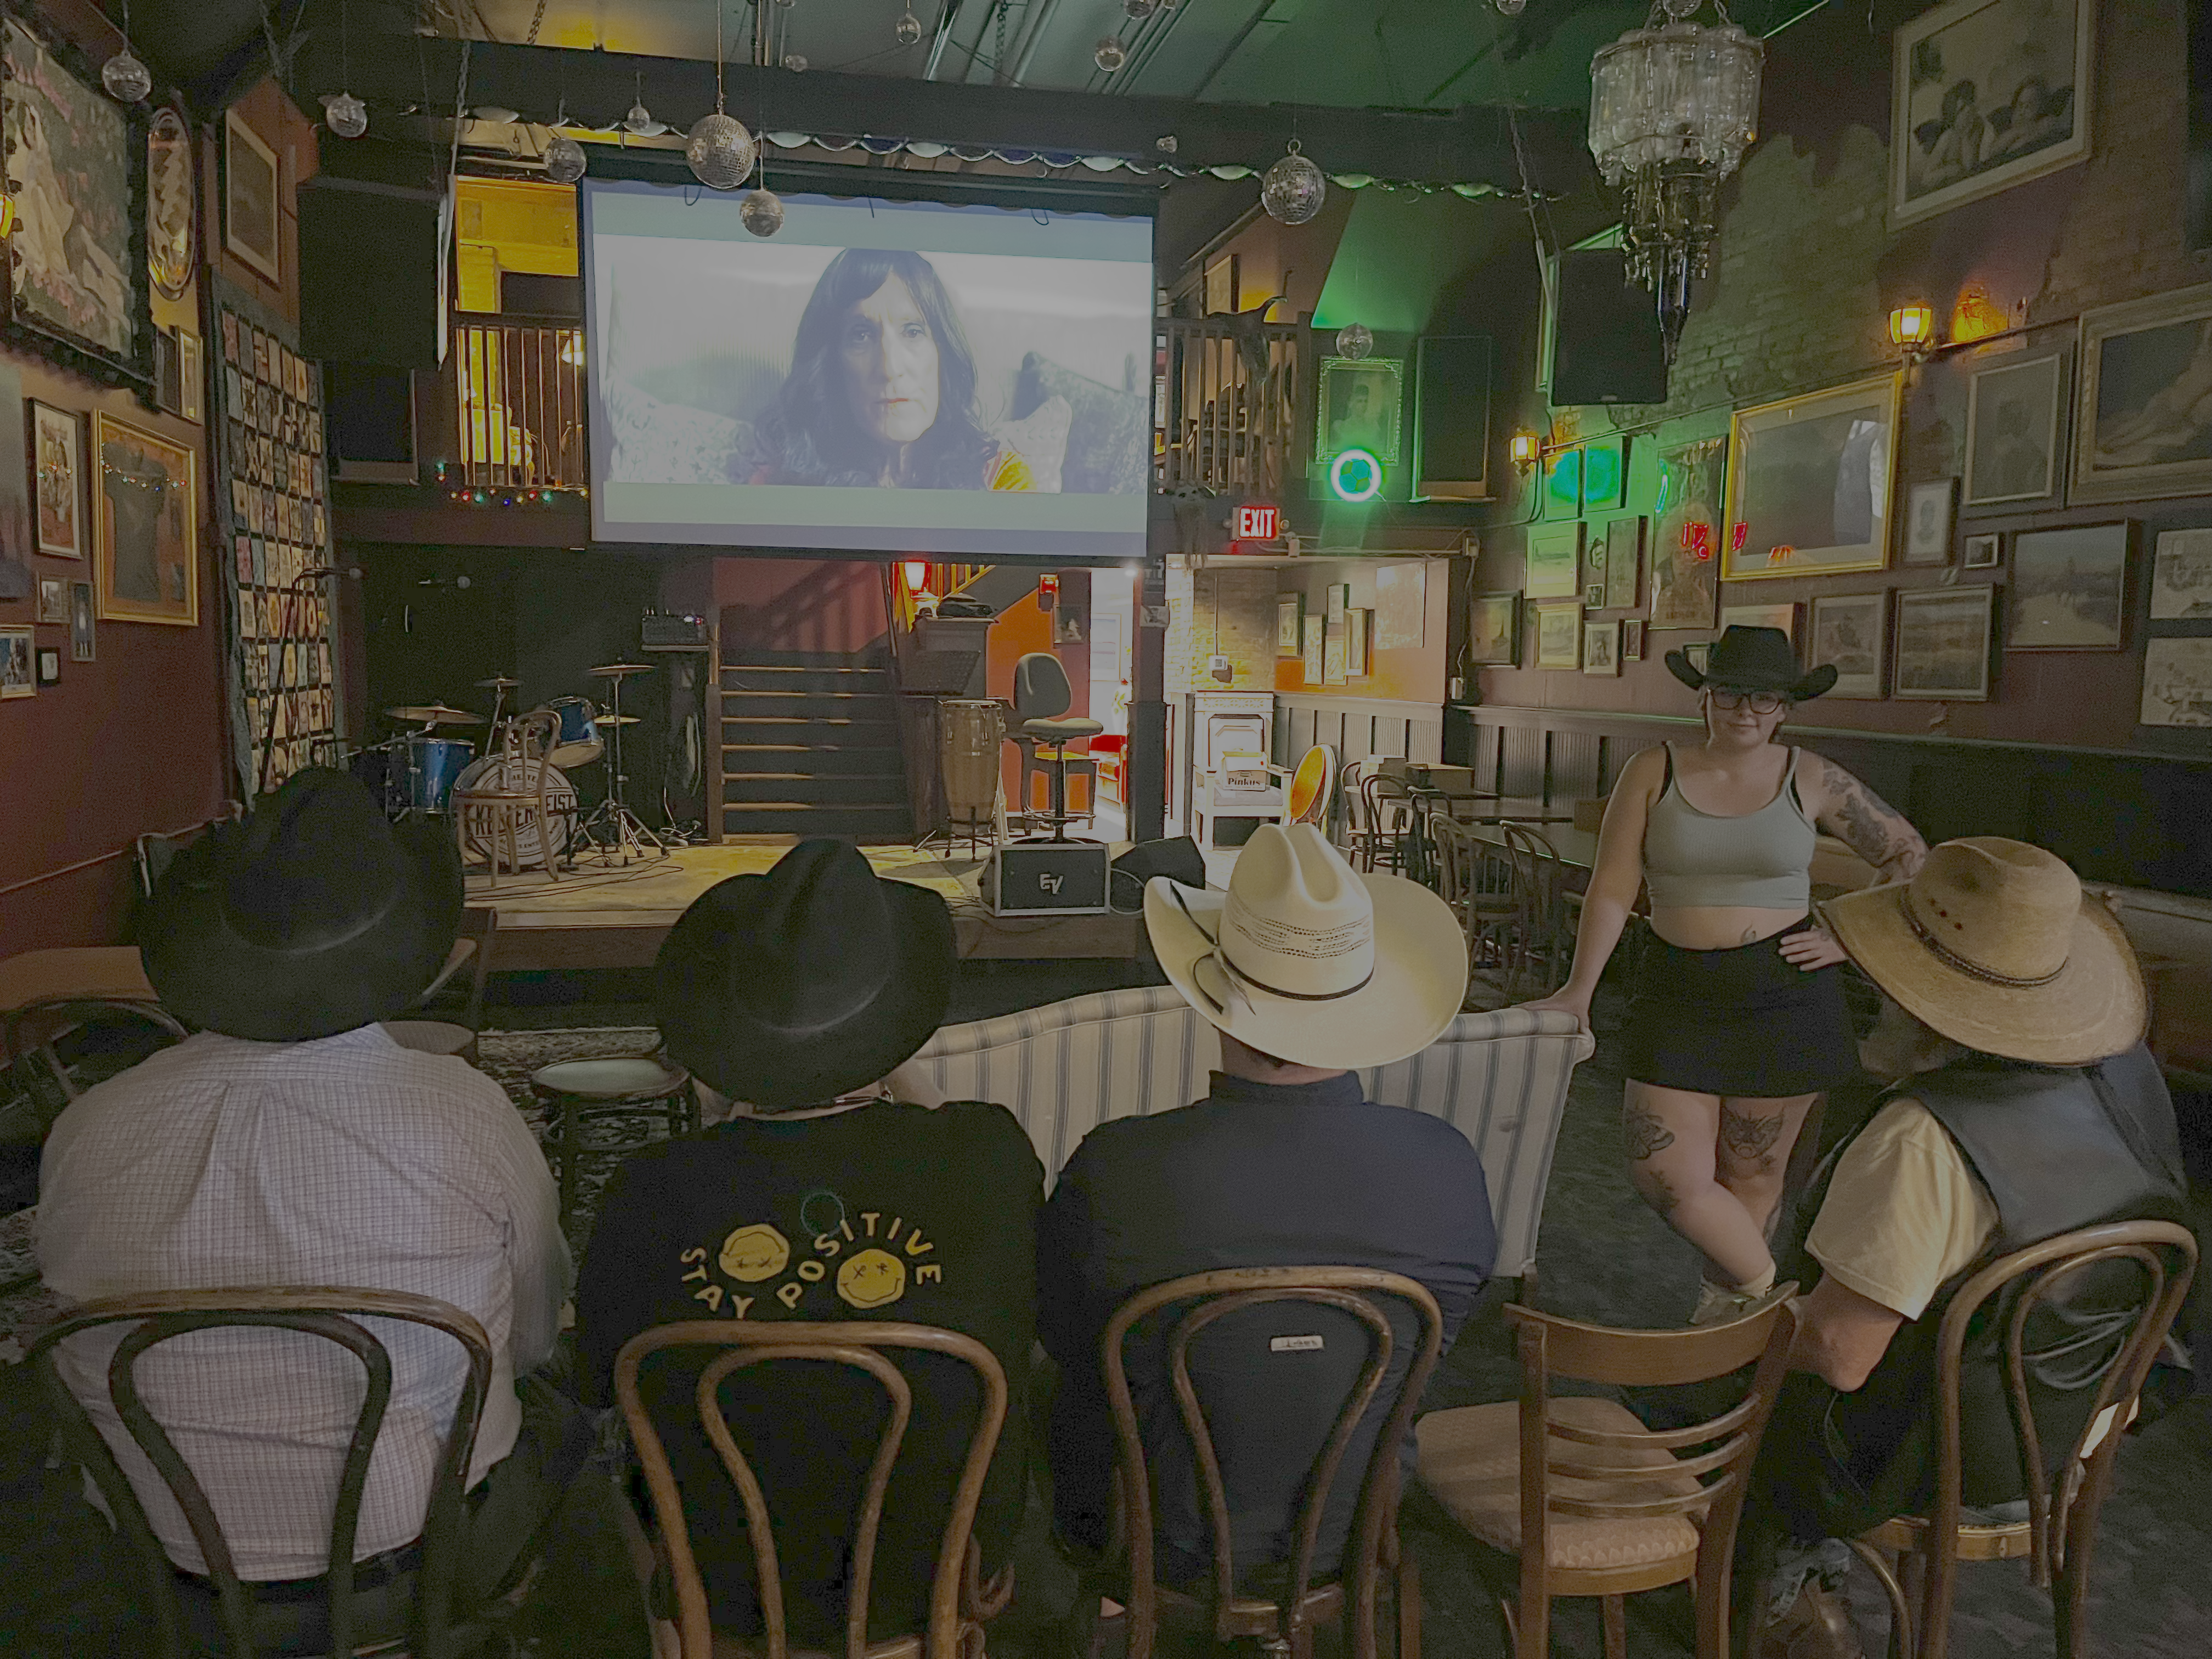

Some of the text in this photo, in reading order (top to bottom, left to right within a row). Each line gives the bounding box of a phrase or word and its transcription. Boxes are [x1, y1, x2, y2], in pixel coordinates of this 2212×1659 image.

[1240, 509, 1274, 537] EXIT
[1228, 777, 1260, 786] Pinkus
[1040, 873, 1064, 894] EV
[680, 1212, 941, 1319] STAY POSITIVE
